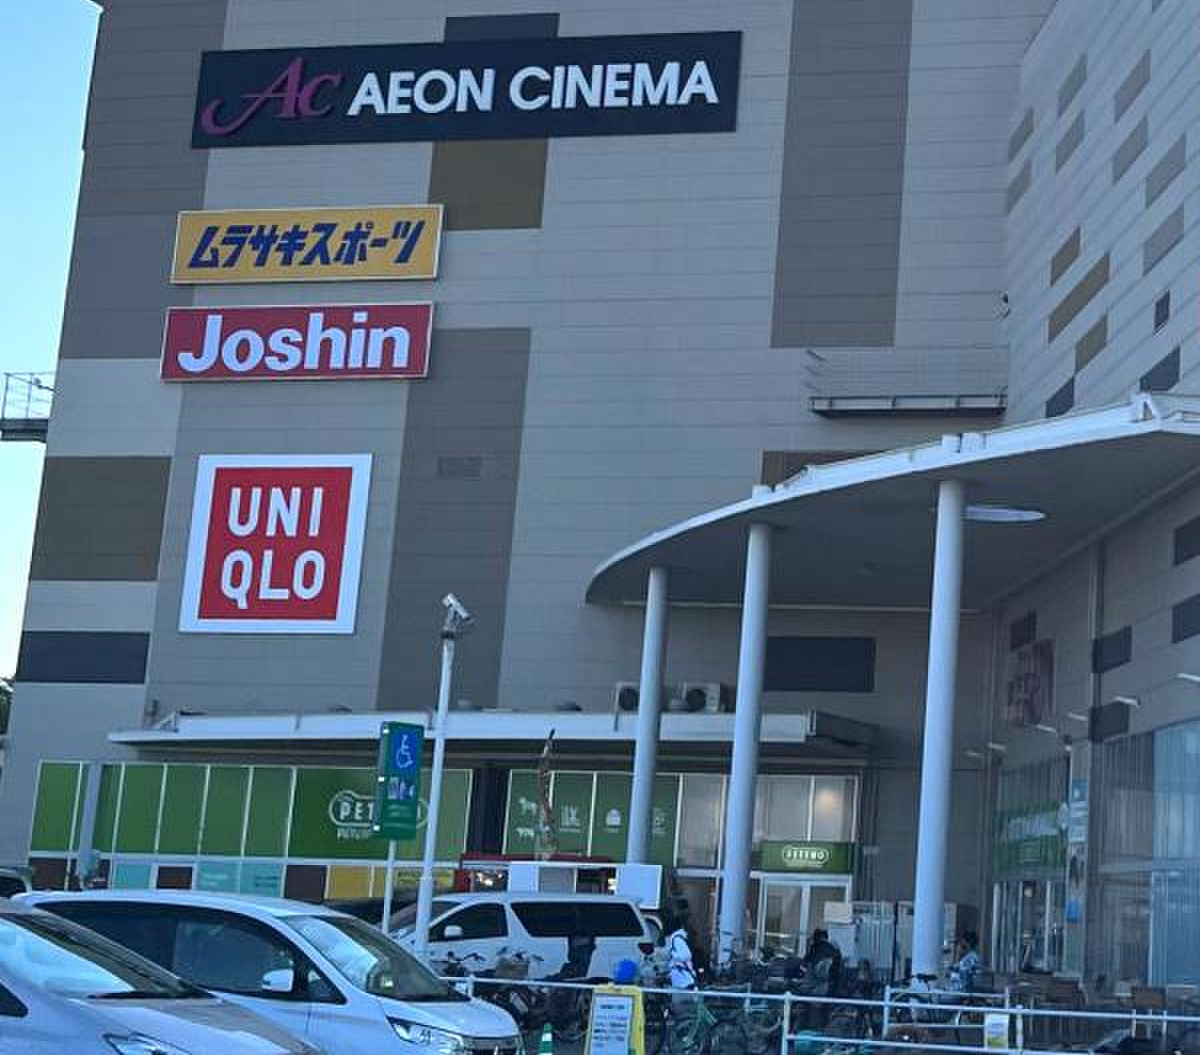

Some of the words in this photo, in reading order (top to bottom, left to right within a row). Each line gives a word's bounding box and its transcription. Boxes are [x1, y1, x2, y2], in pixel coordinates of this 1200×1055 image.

[347, 67, 495, 116] AEON
[508, 59, 719, 111] CINEMA
[188, 220, 426, 269] ムラサキスポーツ
[176, 310, 411, 372] Joshin
[227, 486, 323, 537] UNI
[220, 549, 326, 610] QLO
